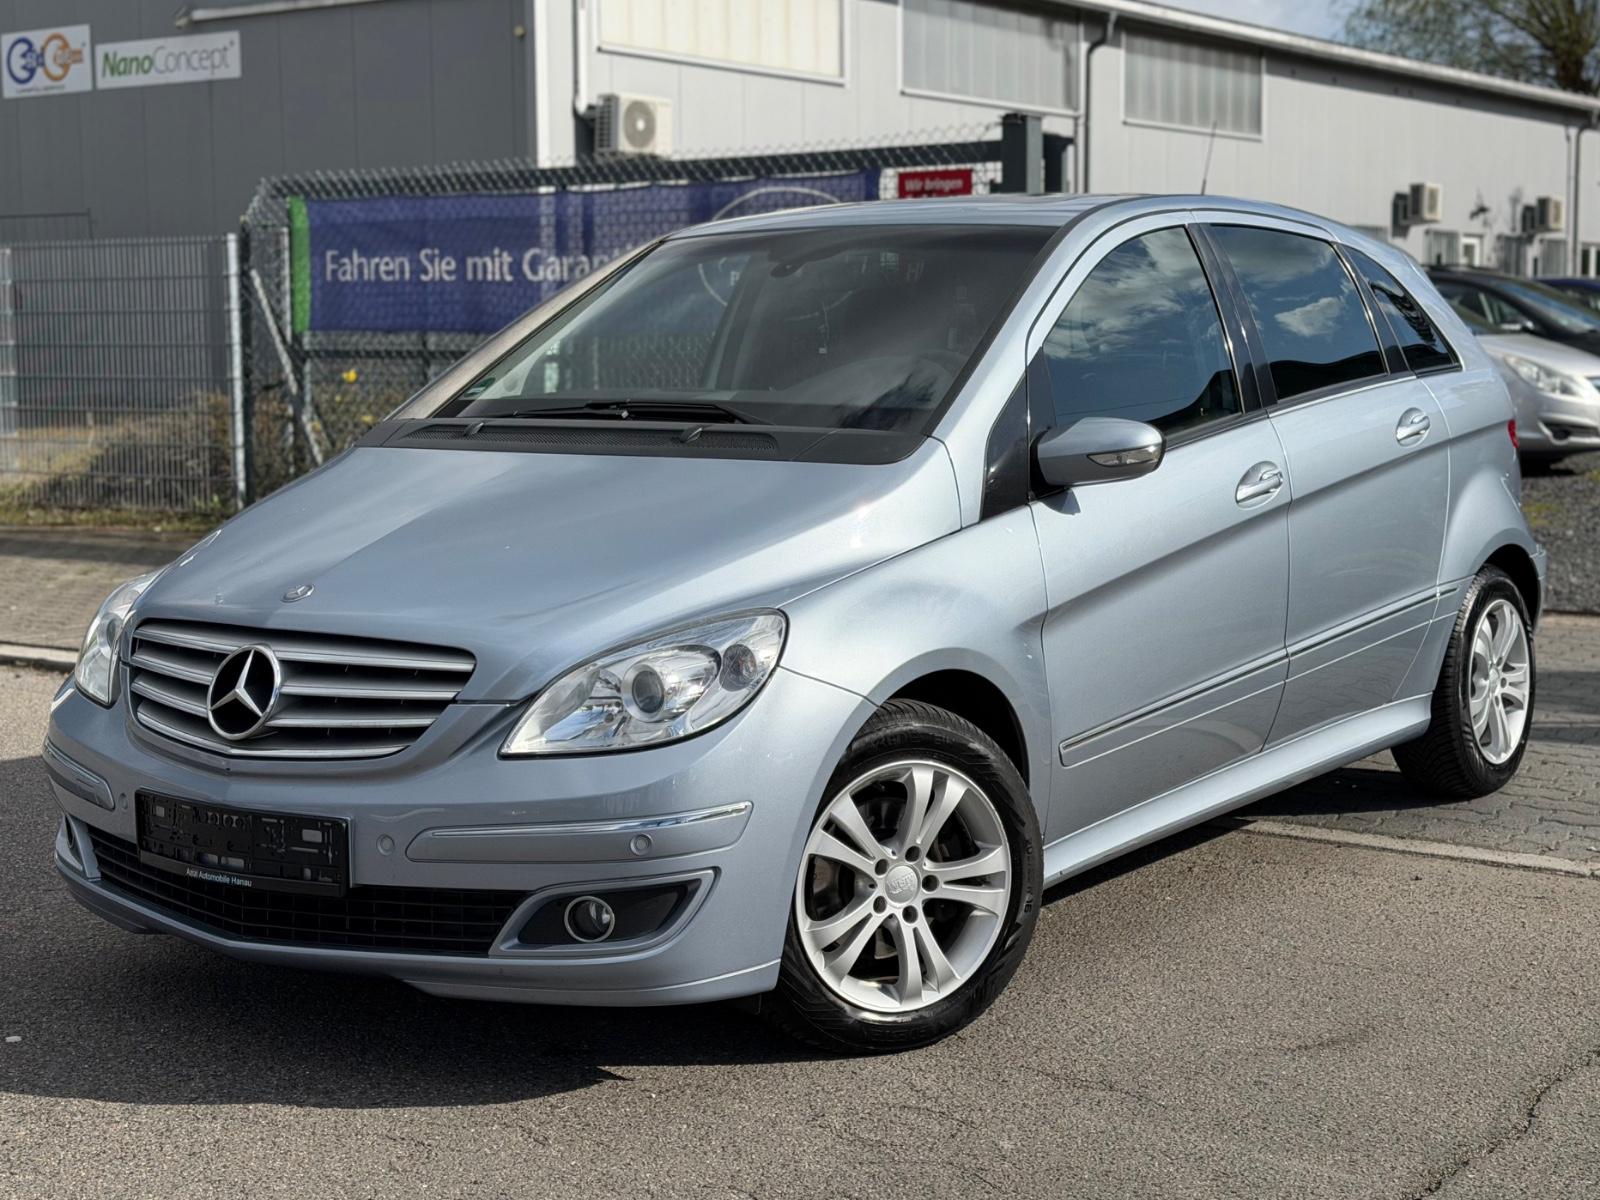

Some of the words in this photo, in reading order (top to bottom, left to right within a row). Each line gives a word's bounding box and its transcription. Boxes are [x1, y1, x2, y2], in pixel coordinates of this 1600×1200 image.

[101, 45, 230, 77] NanoConcept
[325, 249, 410, 282] Fahren
[418, 250, 457, 281] Sie
[466, 247, 514, 281] mit
